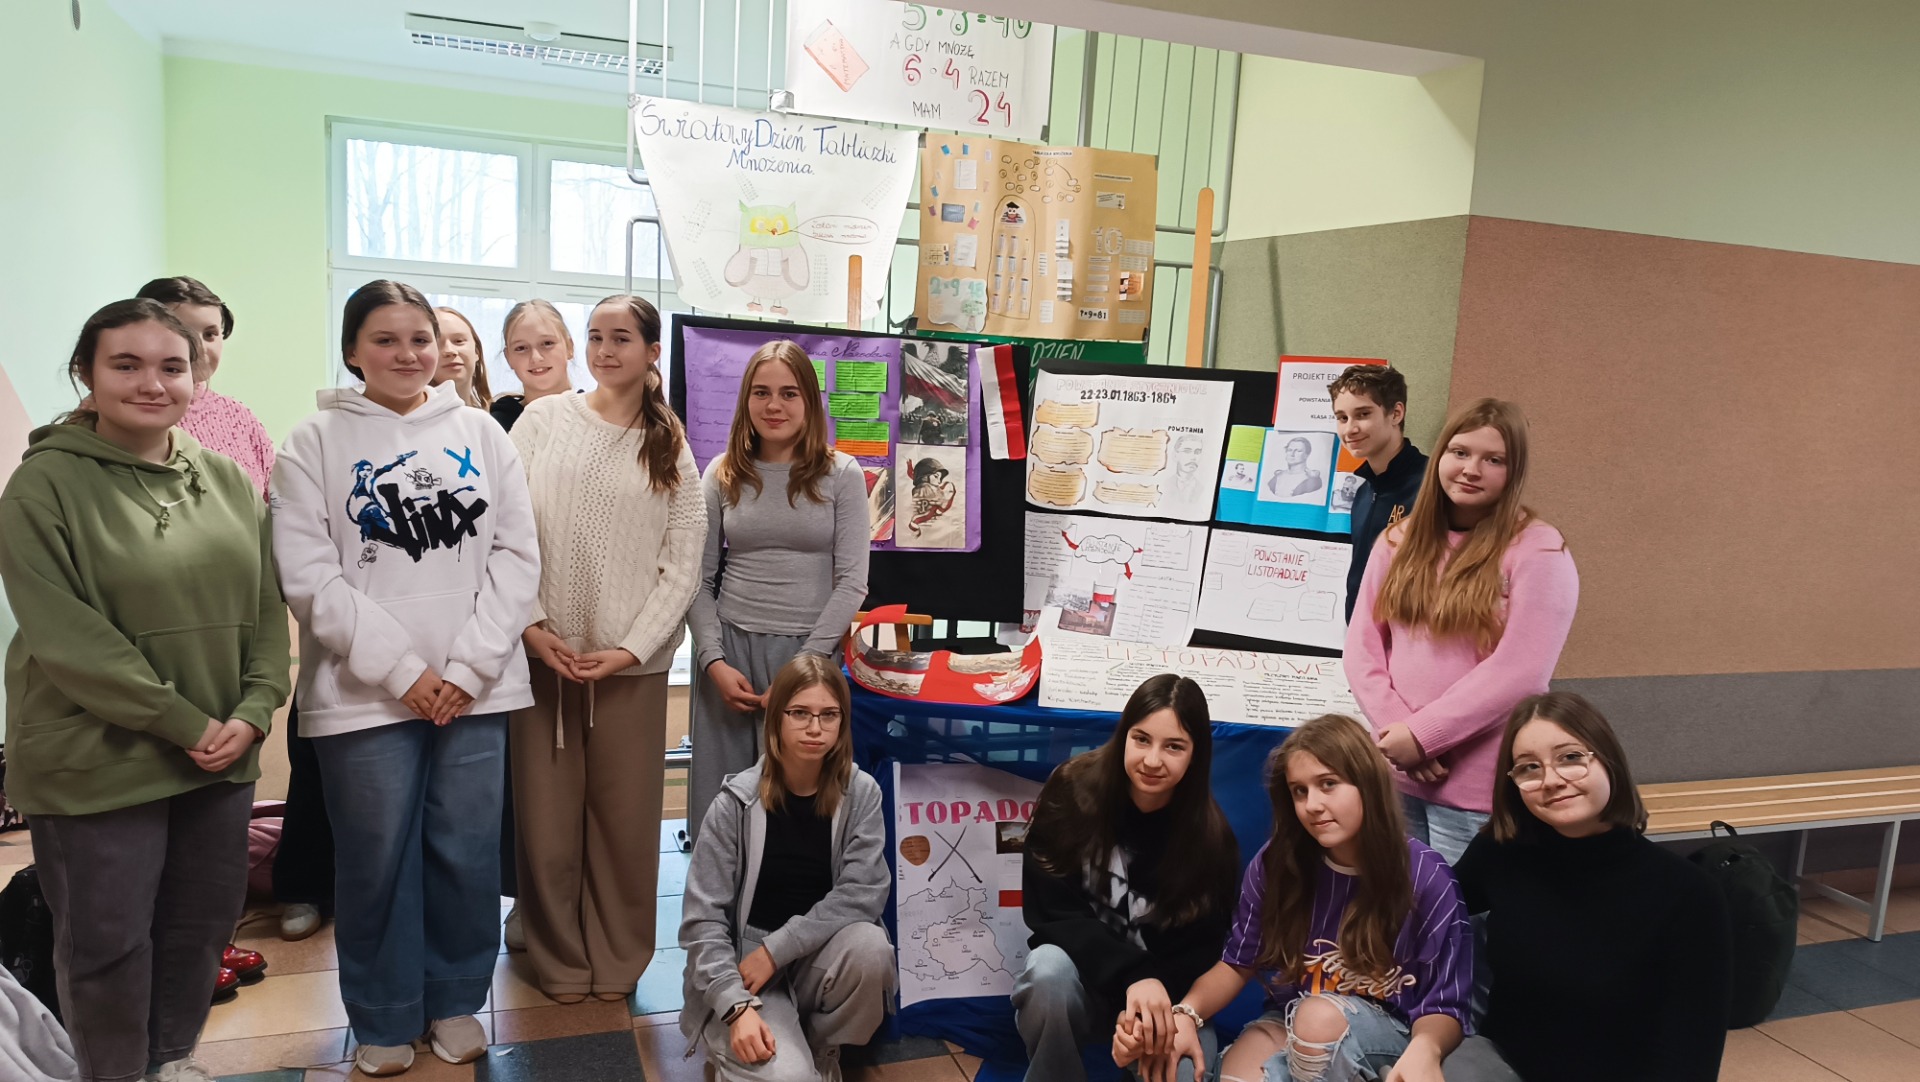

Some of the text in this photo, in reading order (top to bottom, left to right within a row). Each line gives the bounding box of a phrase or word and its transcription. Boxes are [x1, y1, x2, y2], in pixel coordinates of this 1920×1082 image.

[889, 32, 900, 49] A
[904, 35, 931, 52] GDY
[968, 66, 1009, 89] RAZEM
[913, 89, 1011, 127] MAM 24
[639, 99, 897, 163] Światowy Dzień Tabliczki
[1292, 372, 1325, 380] PROJEKT
[1168, 425, 1204, 434] POWSTANIA
[1254, 548, 1304, 566] POWSTANIE
[1247, 564, 1308, 582] LISTOPADOWE
[899, 799, 1037, 825] TOPADO
